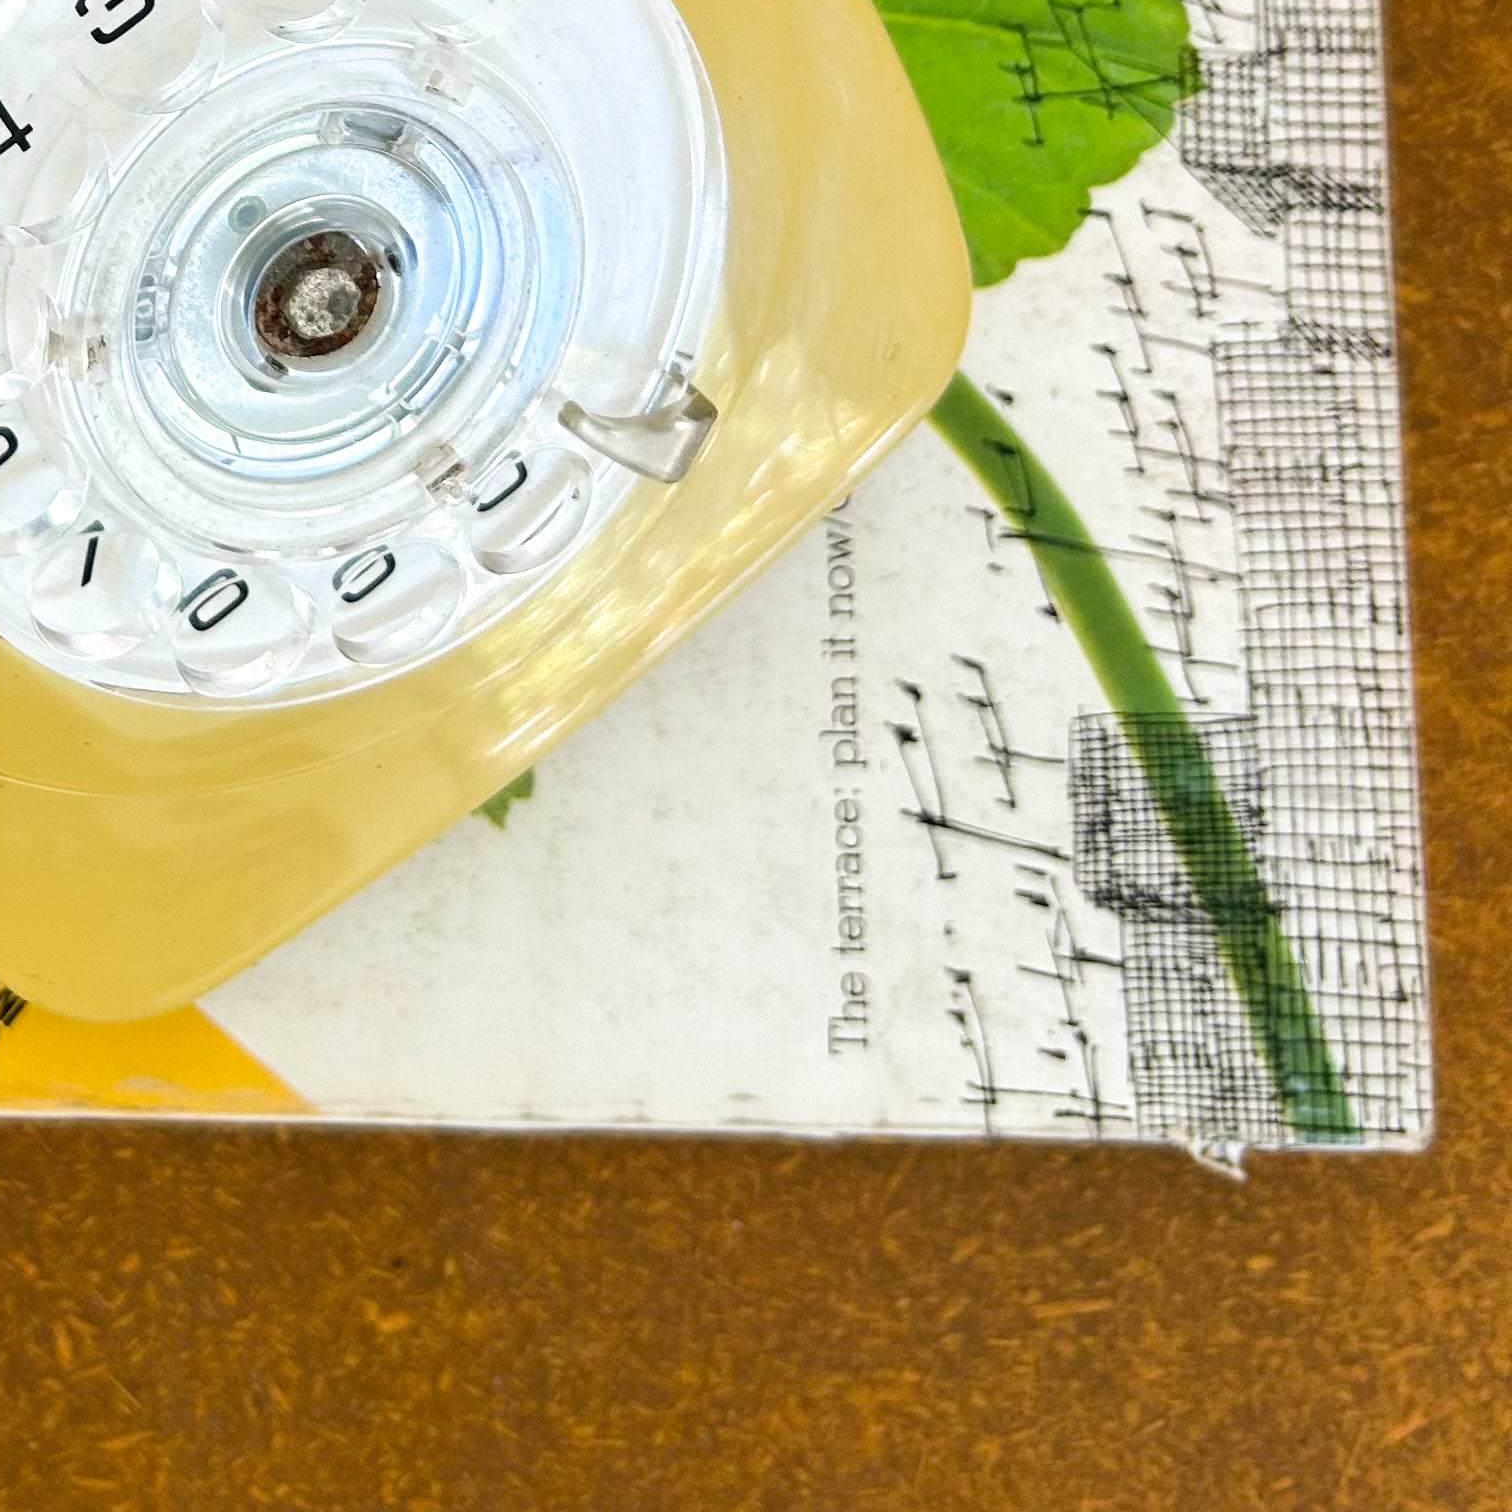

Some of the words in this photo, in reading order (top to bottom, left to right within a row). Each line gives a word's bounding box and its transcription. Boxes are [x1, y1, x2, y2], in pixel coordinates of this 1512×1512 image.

[819, 634, 857, 662] it
[818, 676, 869, 768] plan
[827, 971, 869, 1056] The
